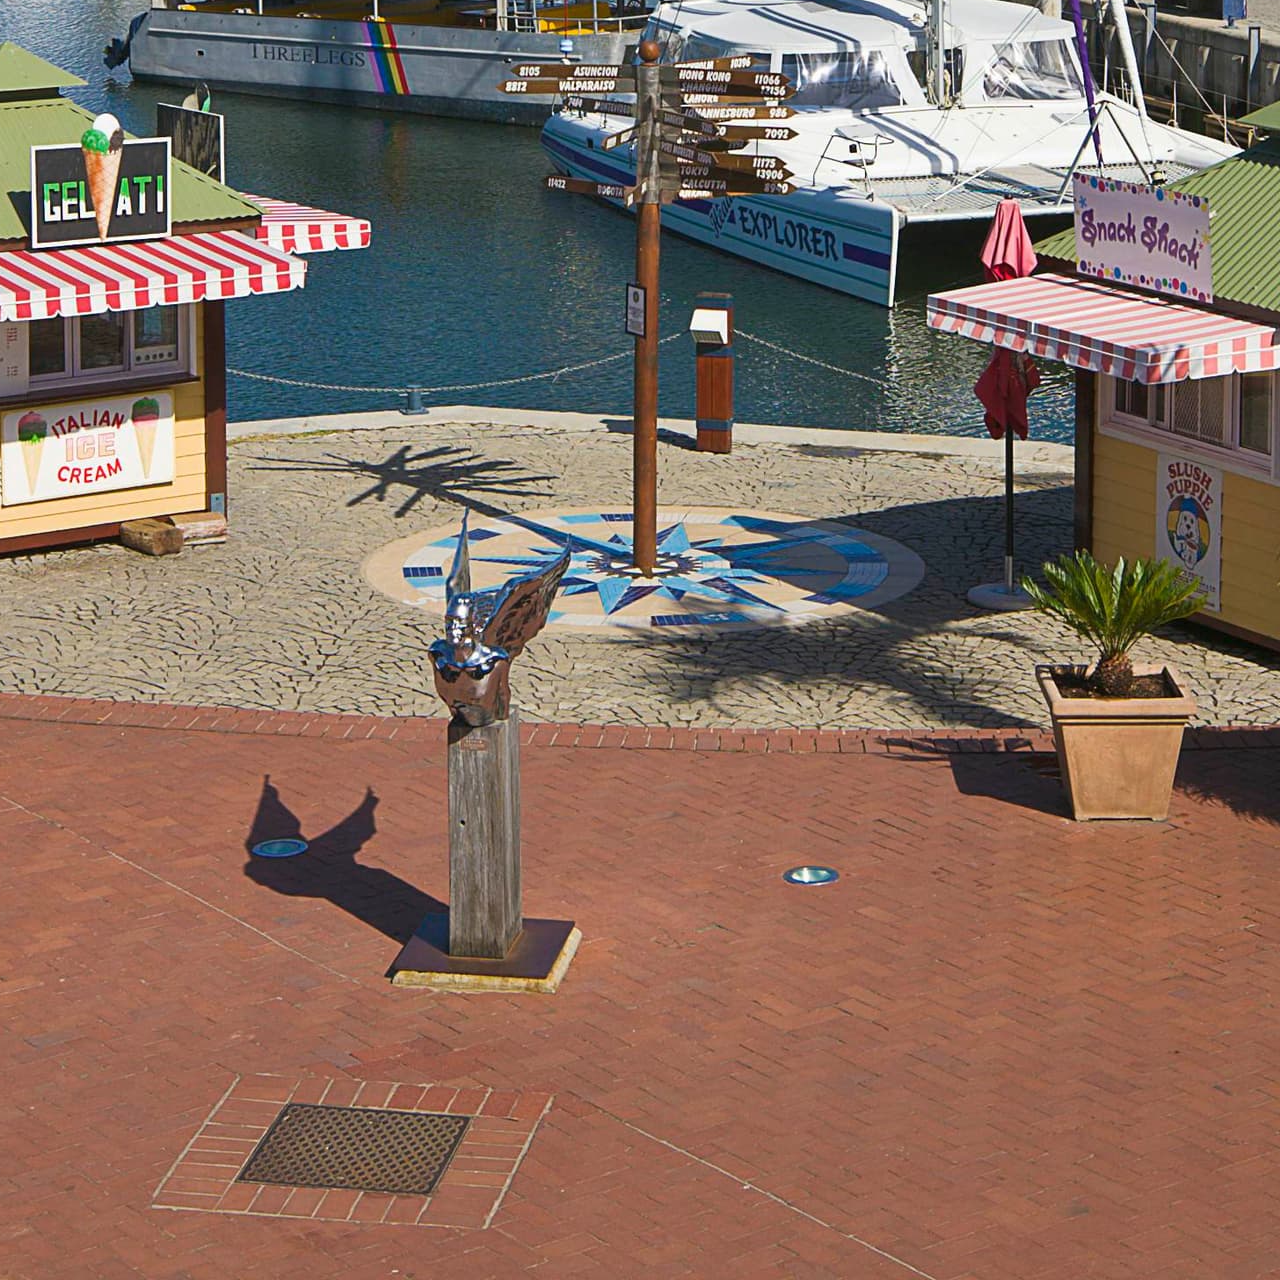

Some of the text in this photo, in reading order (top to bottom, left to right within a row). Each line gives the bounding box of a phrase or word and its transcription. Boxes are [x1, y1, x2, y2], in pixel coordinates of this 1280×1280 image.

[519, 66, 618, 77] 8105 ASUNCION
[679, 70, 781, 85] HONG KONG 11066
[505, 80, 615, 92] 8812 VALPARAISO
[681, 81, 728, 93] SHANGHAI
[770, 107, 788, 118] 986
[765, 128, 789, 138] 7092
[752, 158, 776, 169] 11175
[681, 166, 784, 180] TOKYO 13906
[682, 179, 727, 190] CALCUTTA
[737, 205, 839, 262] EXPLORER
[1081, 208, 1199, 270] Snack Shack
[51, 409, 125, 439] ITALIAN
[65, 431, 116, 462] ICE
[57, 458, 123, 484] CREAM
[1167, 461, 1212, 491] SLUSH
[1166, 478, 1214, 511] PUPPIE
